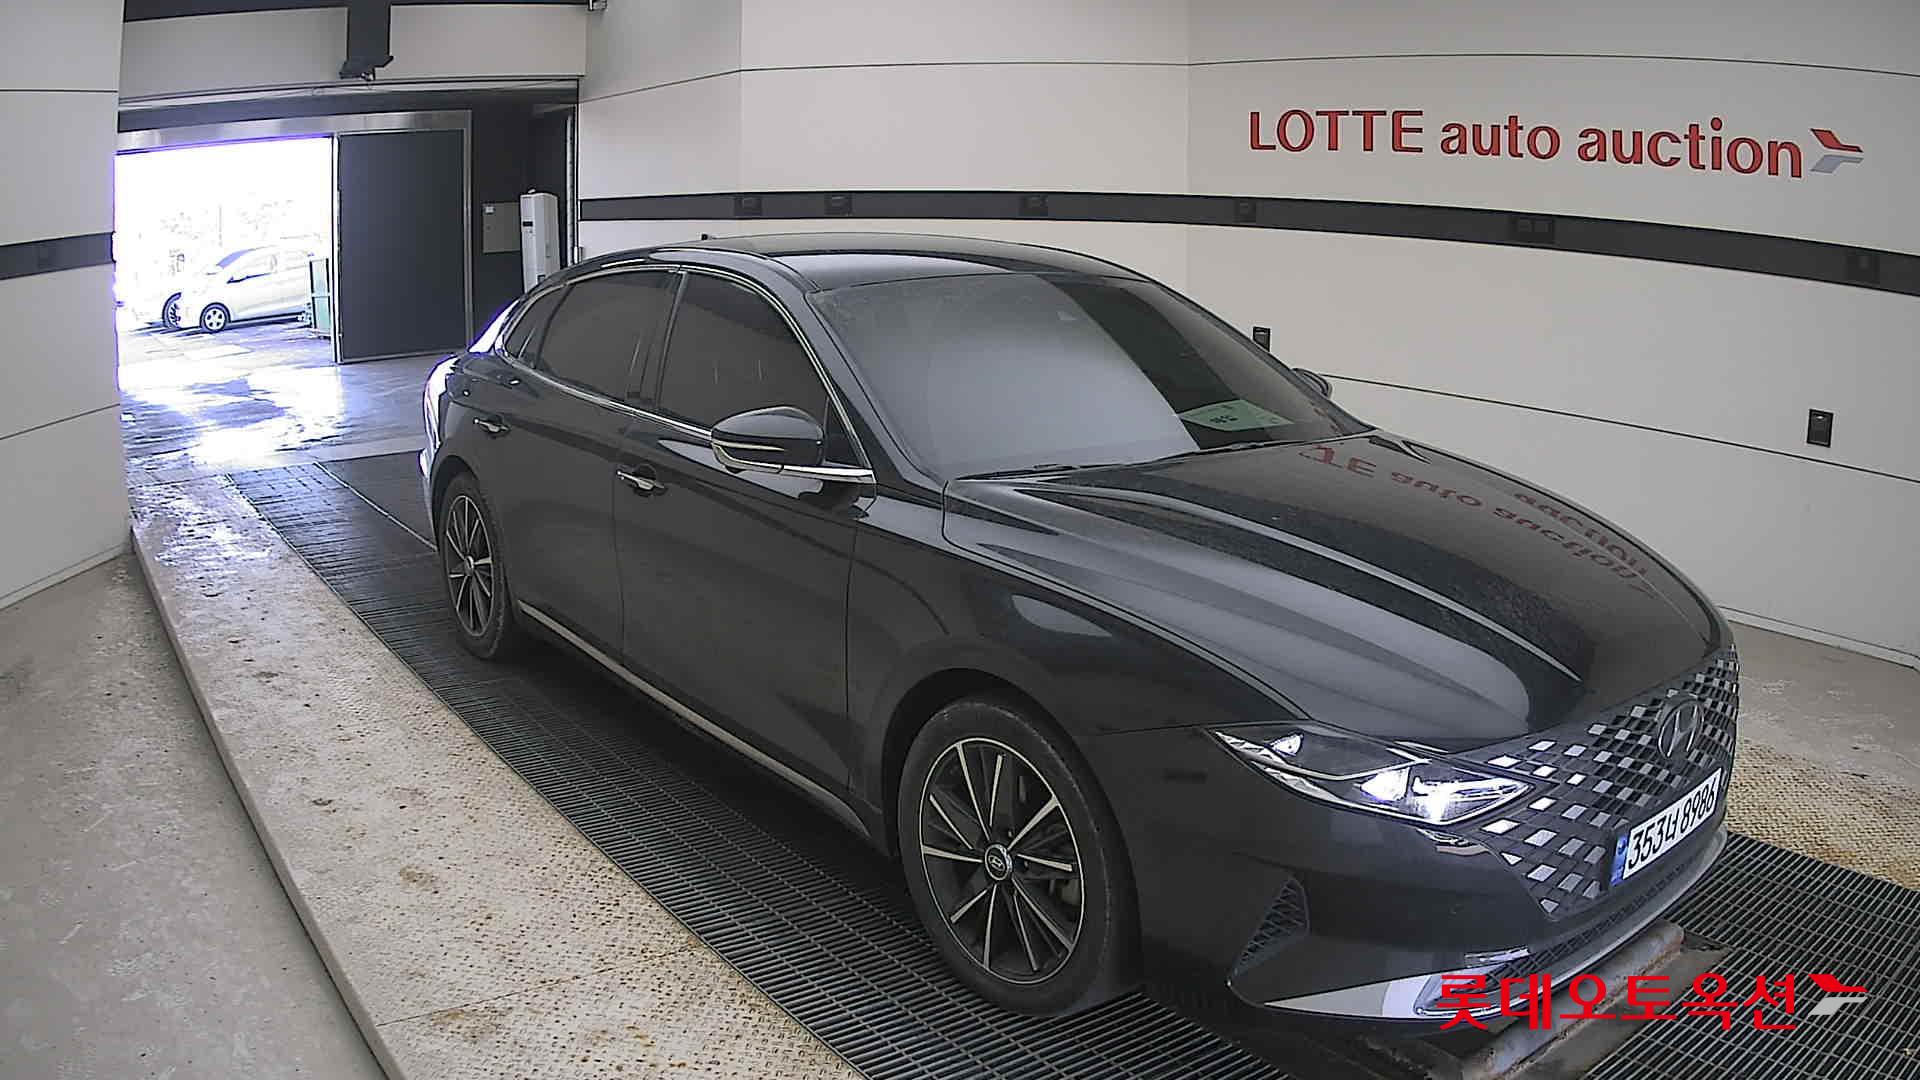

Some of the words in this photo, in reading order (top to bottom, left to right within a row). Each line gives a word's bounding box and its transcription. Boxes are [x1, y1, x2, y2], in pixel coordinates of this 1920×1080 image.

[1249, 110, 1424, 153] LOTTE
[1440, 115, 1561, 160] auto
[1577, 117, 1804, 178] auction
